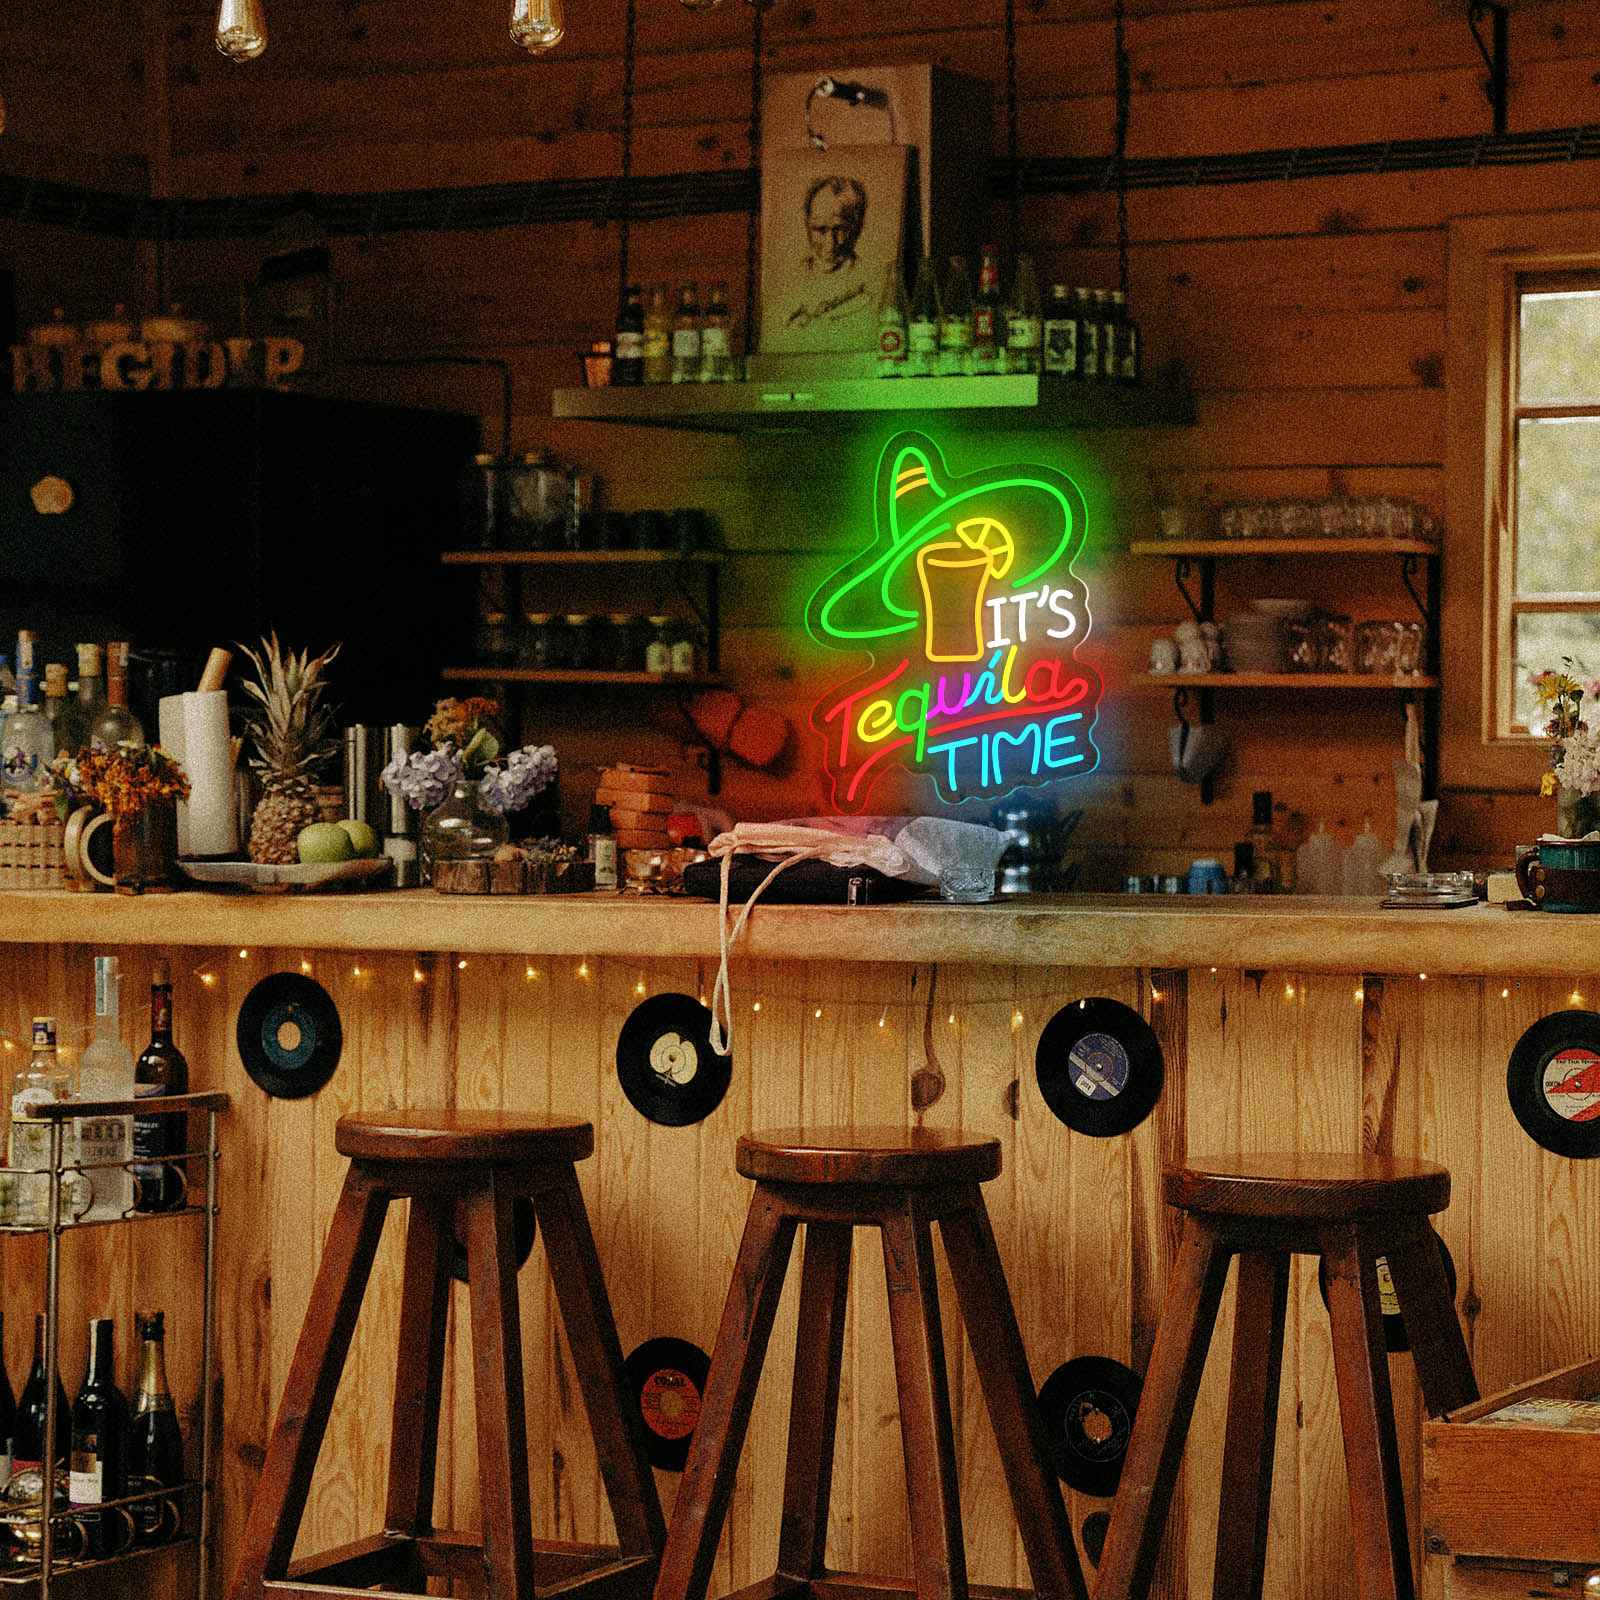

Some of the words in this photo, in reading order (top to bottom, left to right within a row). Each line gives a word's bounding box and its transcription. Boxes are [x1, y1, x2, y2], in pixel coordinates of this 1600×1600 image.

[985, 584, 1077, 648] IT'S
[825, 645, 1089, 768] Tequila
[926, 712, 1085, 792] TIME
